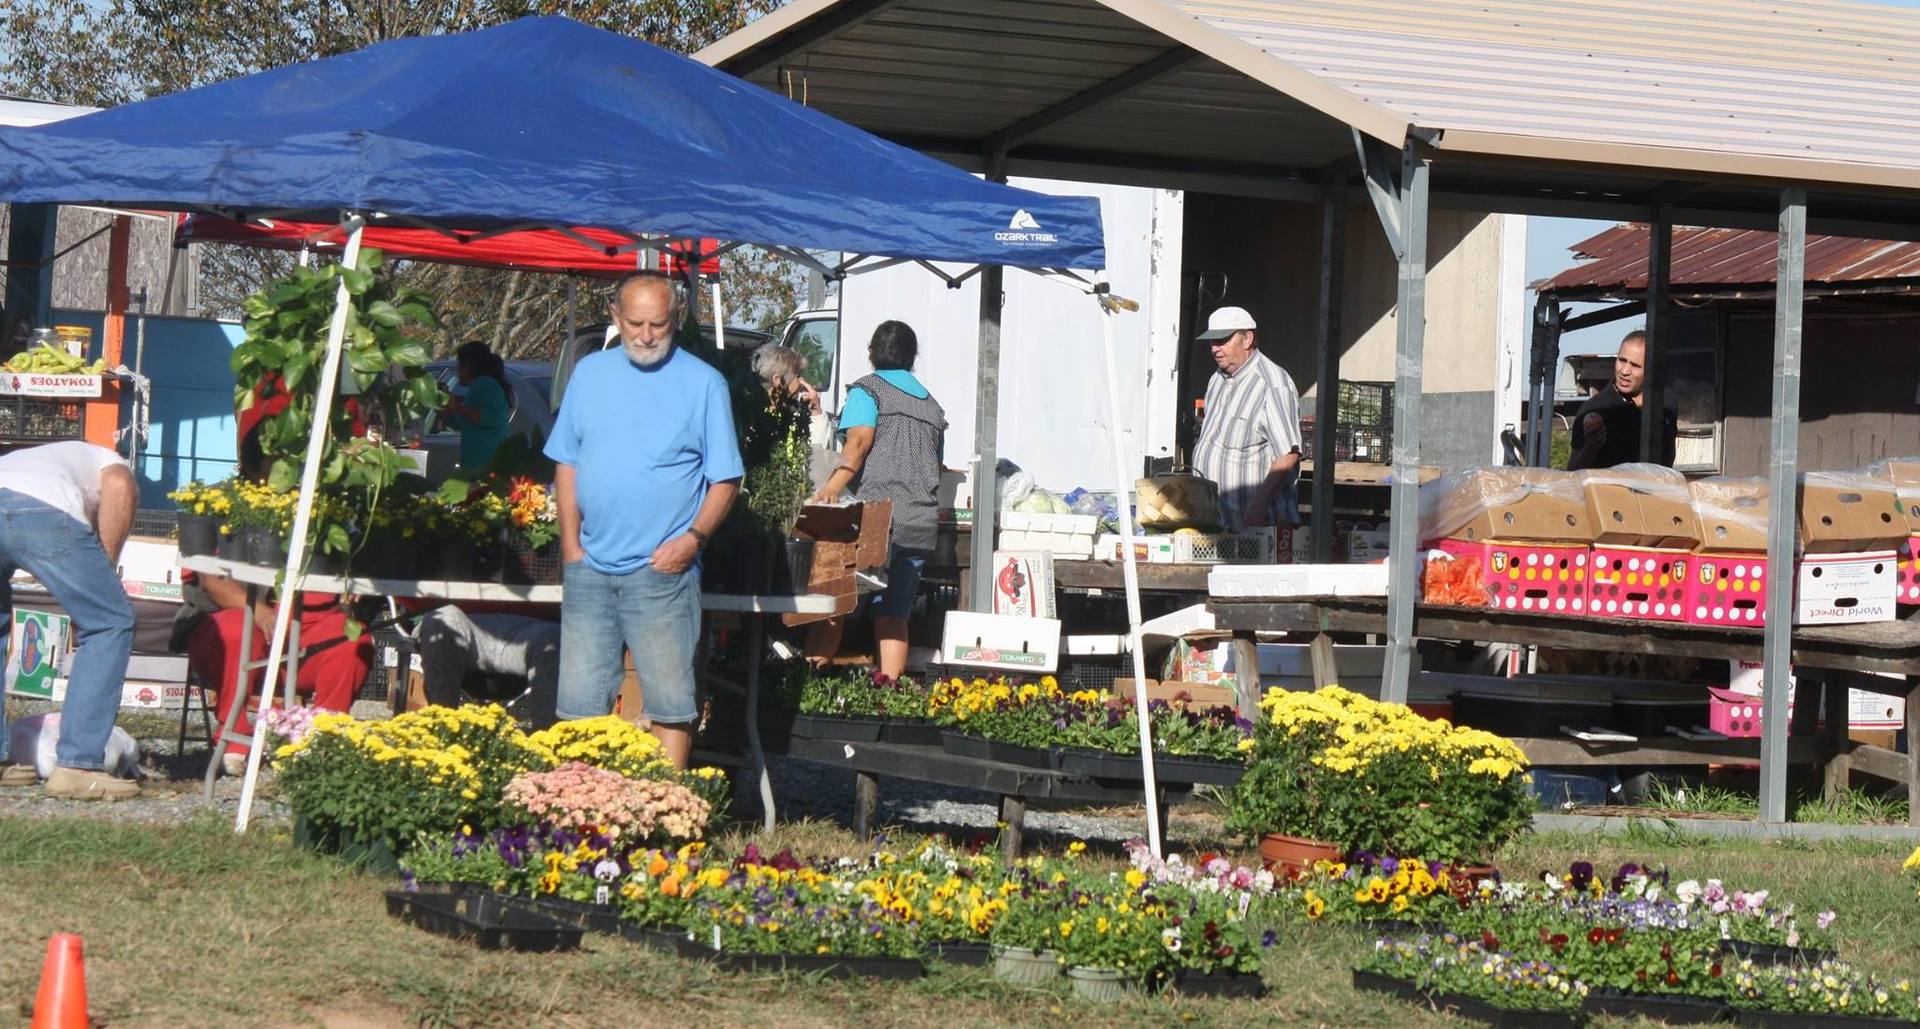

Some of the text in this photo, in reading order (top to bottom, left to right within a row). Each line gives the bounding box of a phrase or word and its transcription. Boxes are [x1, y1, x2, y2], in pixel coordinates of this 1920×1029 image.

[30, 376, 95, 387] TOMATOES
[1809, 607, 1884, 618] World Direct
